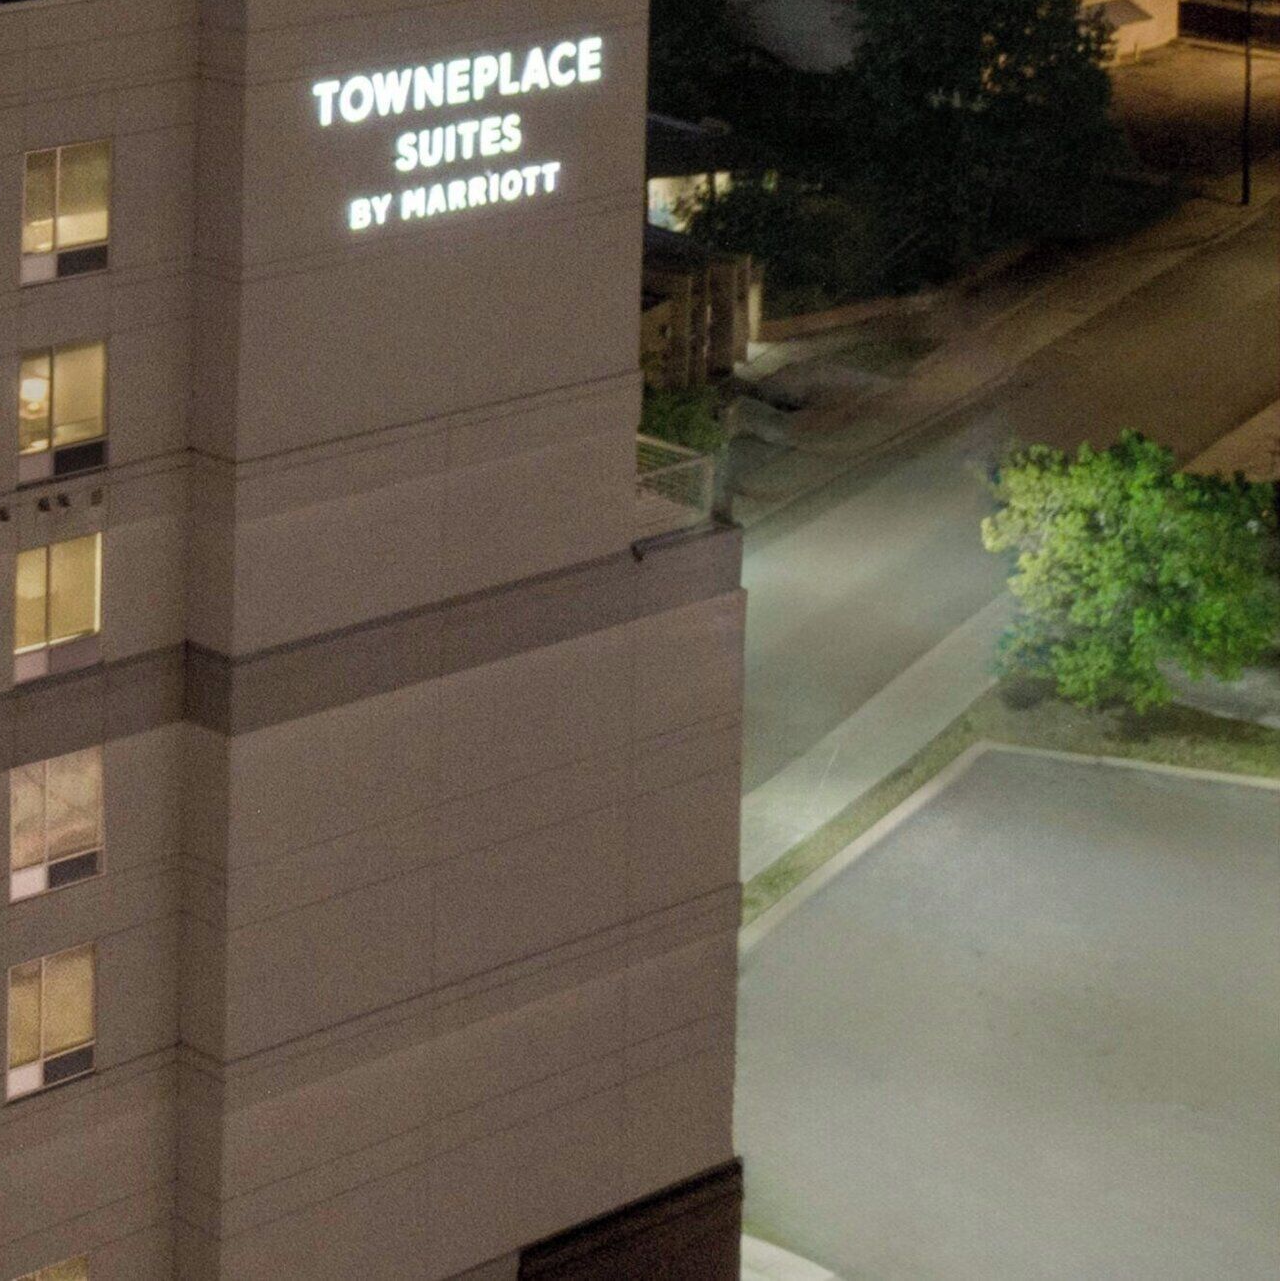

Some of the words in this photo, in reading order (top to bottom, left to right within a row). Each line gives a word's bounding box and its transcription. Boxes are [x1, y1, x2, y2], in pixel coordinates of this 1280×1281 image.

[312, 37, 603, 126] TOWNEPLACE
[394, 114, 523, 172] SUITES
[347, 194, 393, 231] BY
[401, 162, 561, 220] MARRIOTT
